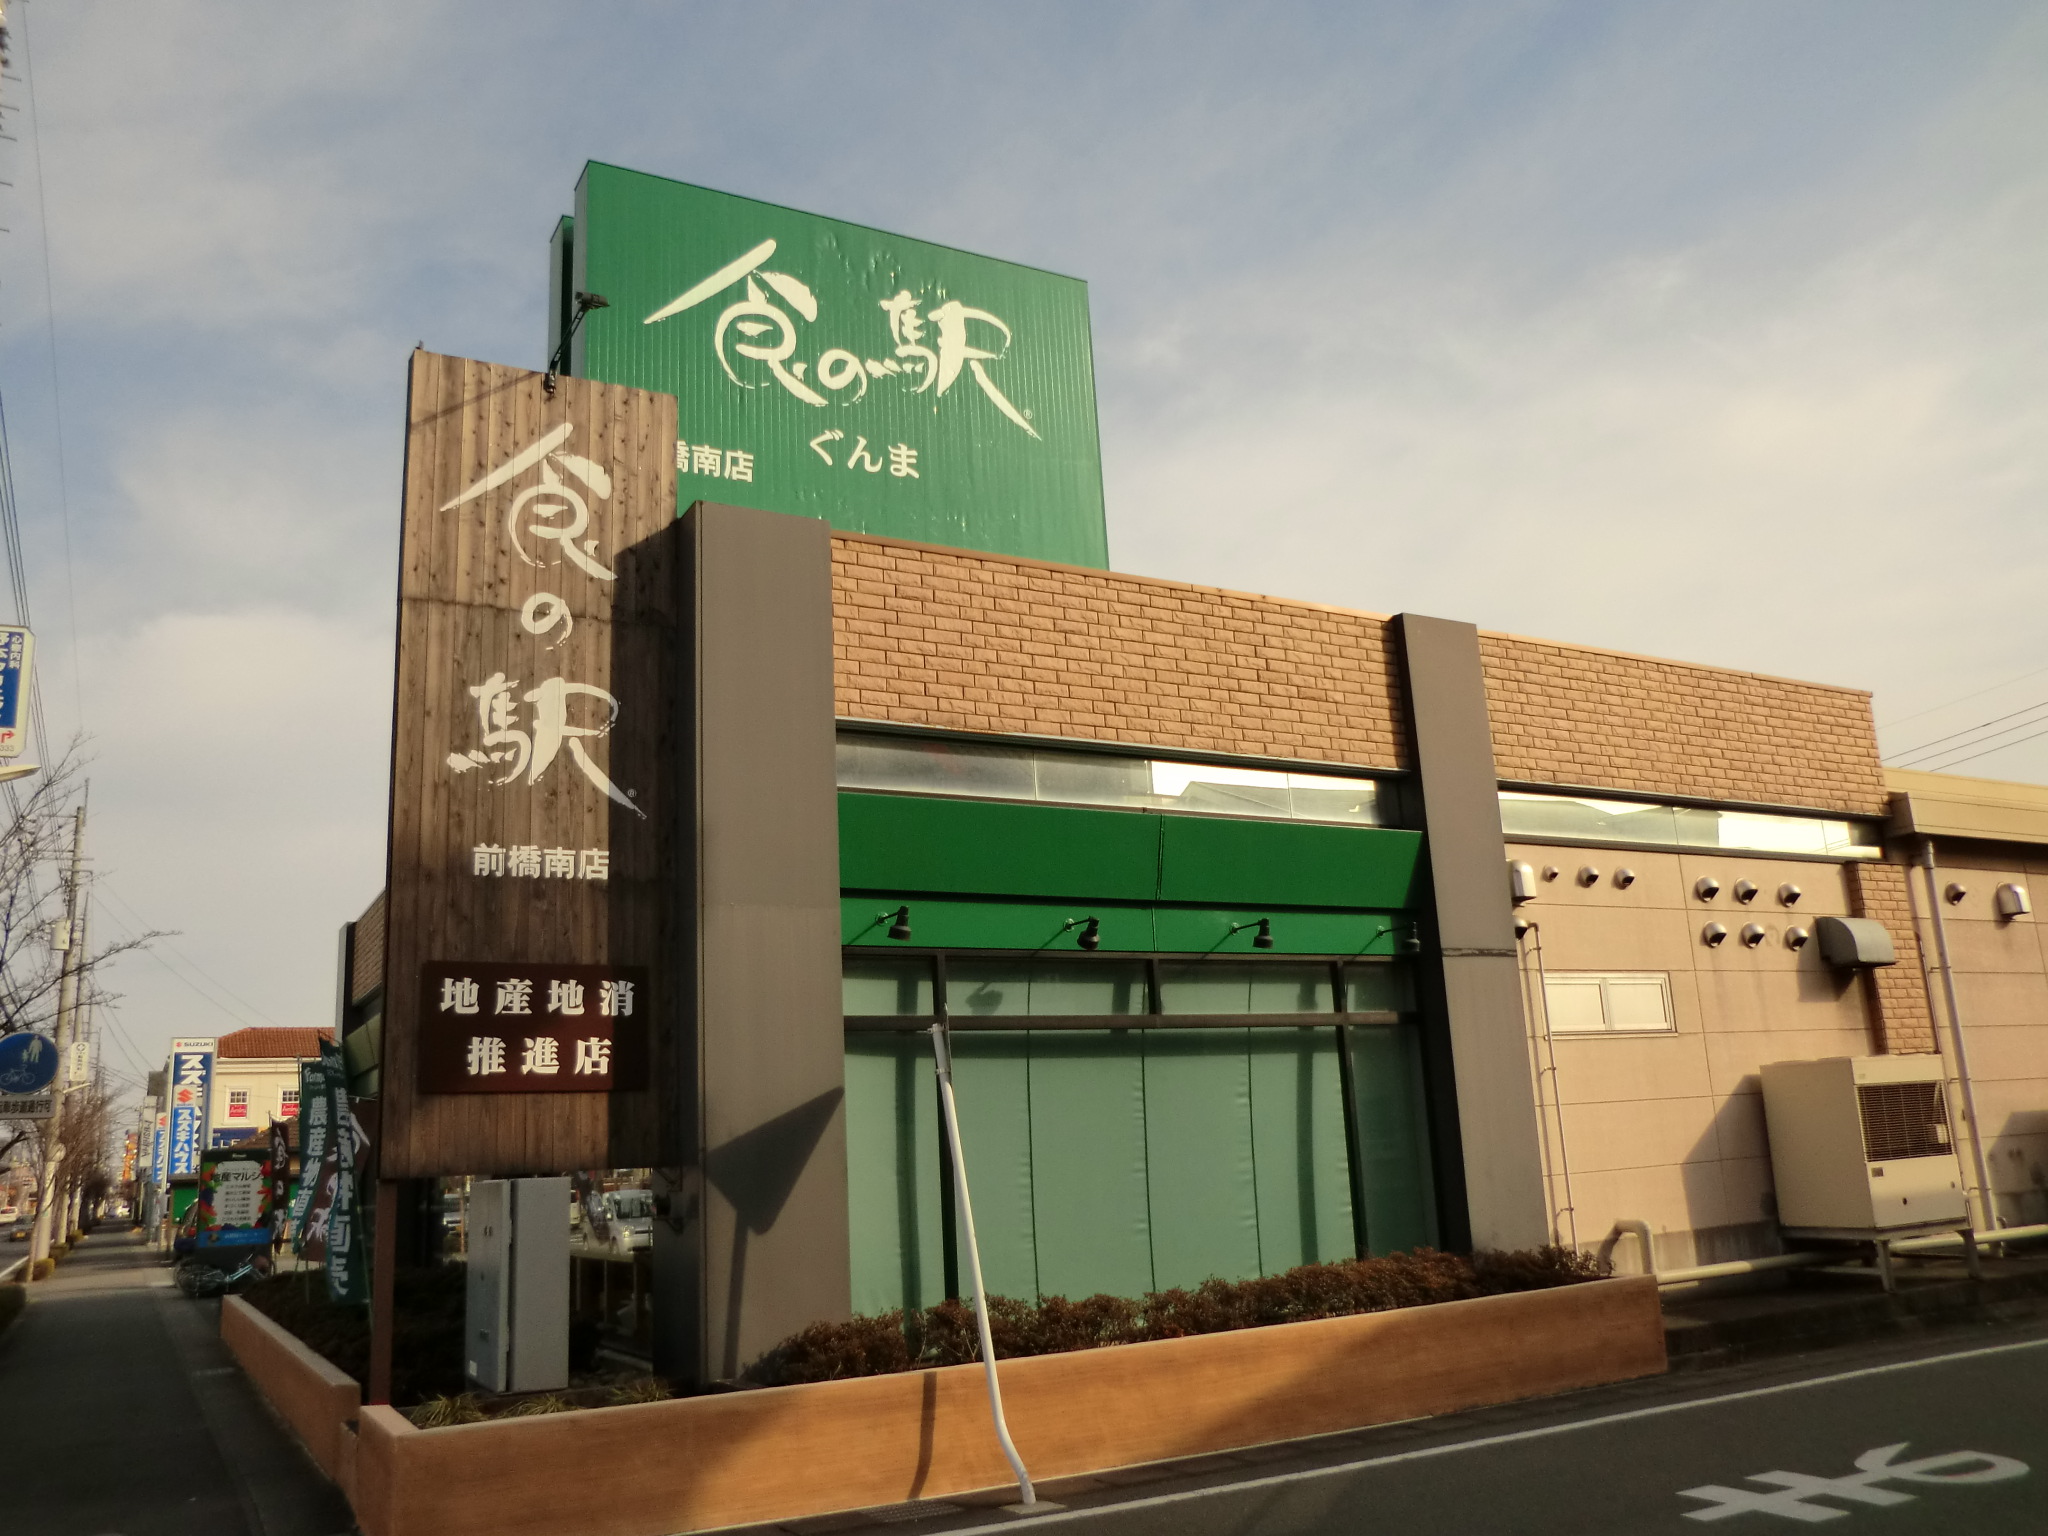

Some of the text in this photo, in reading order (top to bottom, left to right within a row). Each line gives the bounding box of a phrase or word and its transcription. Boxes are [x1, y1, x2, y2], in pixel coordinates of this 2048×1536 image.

[643, 238, 1042, 441] 食の駅
[809, 429, 920, 479] ぐんま
[440, 421, 648, 820] 食の駅
[472, 842, 610, 880] 前橋南店
[440, 977, 635, 1016] 地産地消
[466, 1036, 613, 1076] 推進店
